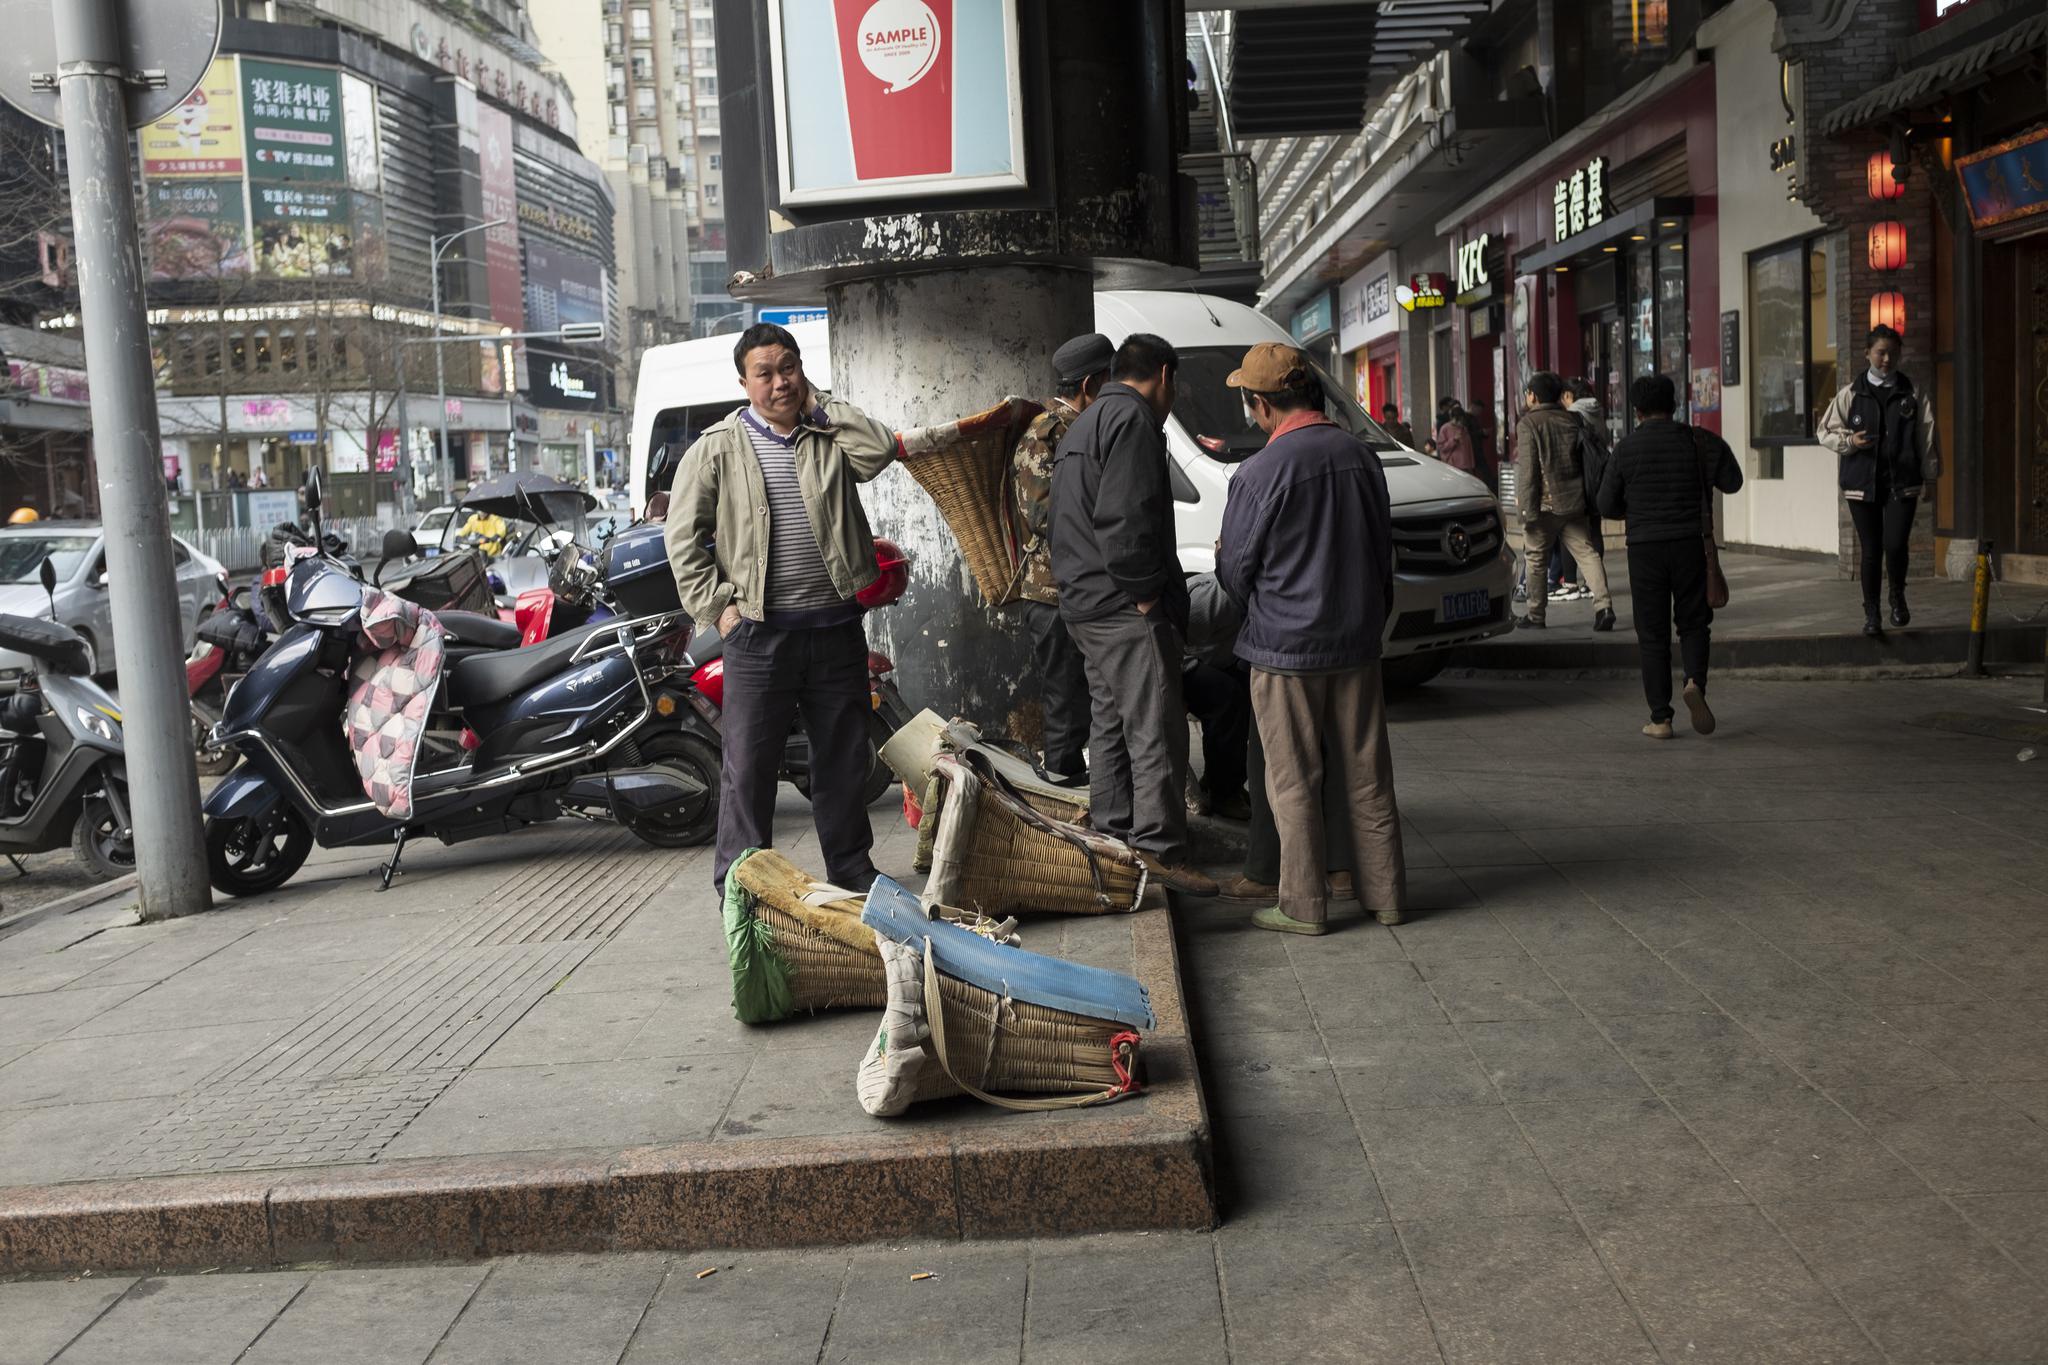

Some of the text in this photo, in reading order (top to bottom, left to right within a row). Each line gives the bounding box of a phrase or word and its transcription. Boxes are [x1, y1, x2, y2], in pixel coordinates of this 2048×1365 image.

[866, 27, 927, 46] SAMPLE
[1554, 156, 1603, 242] 肯德基
[1457, 233, 1489, 295] KFC
